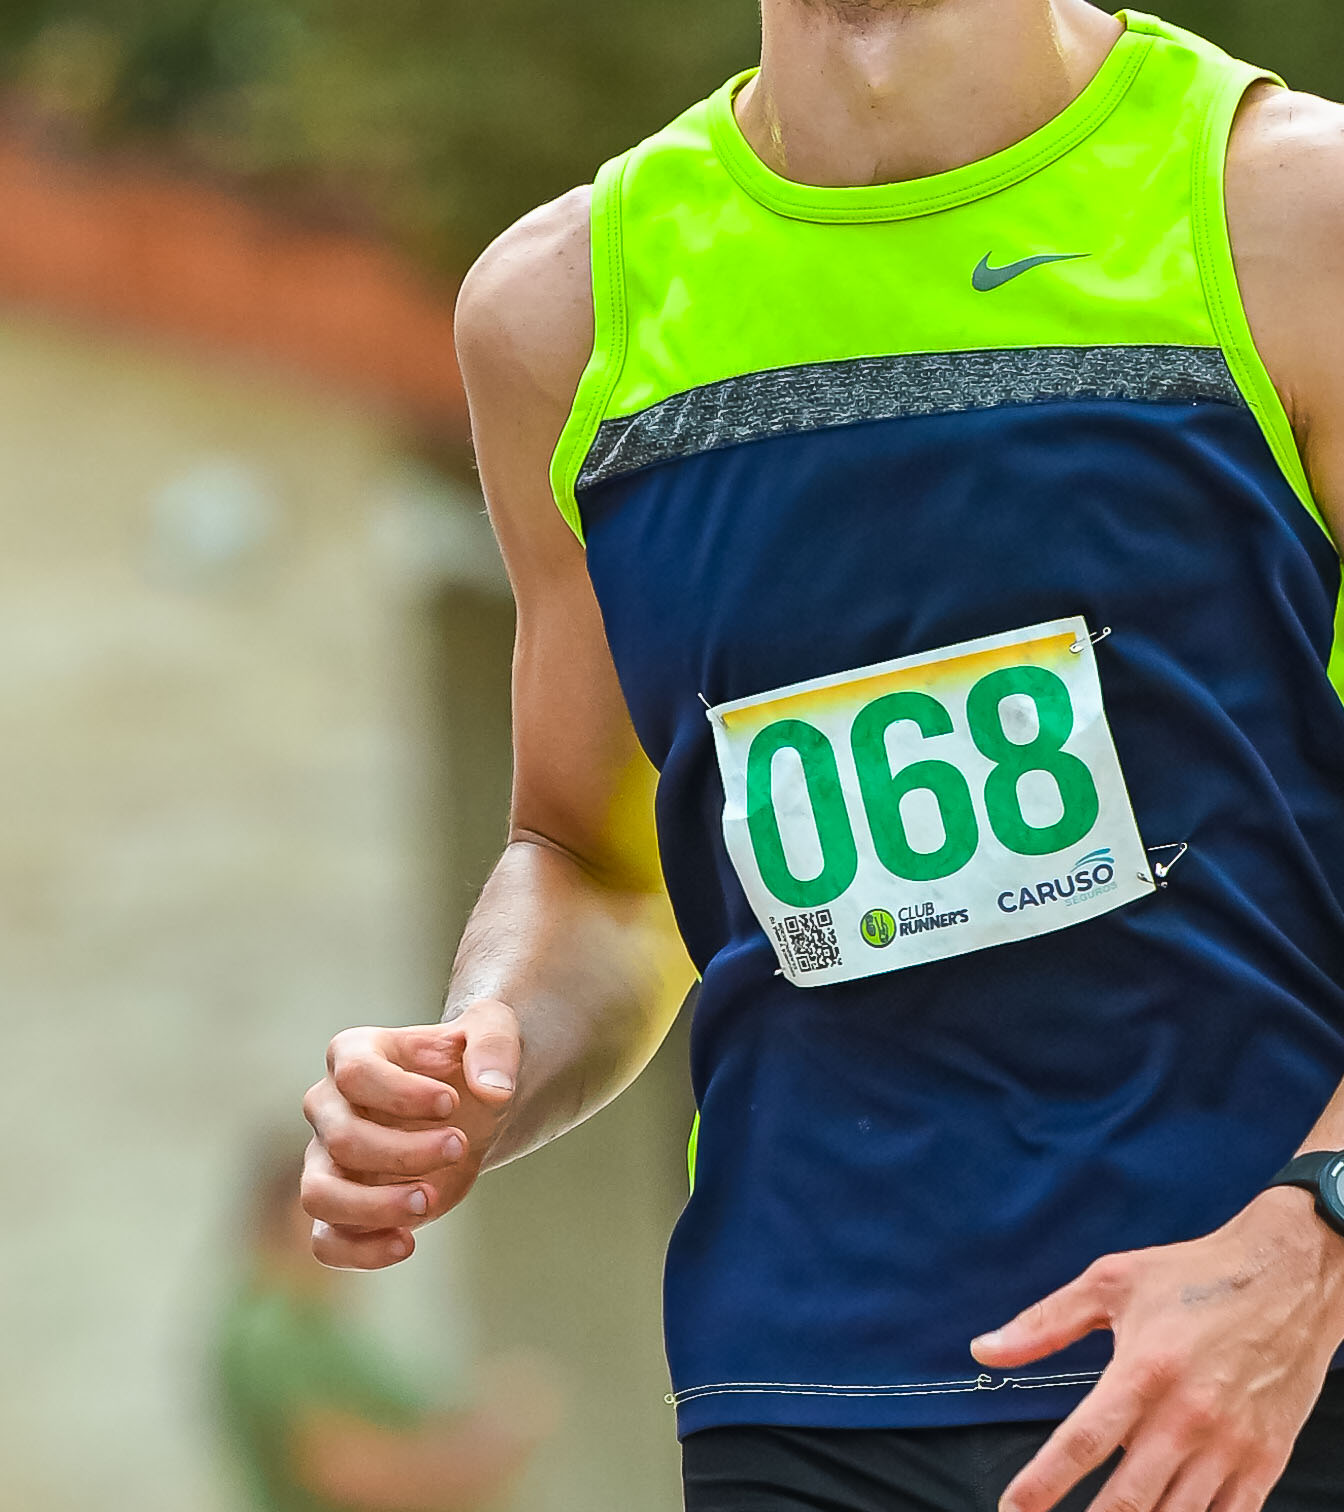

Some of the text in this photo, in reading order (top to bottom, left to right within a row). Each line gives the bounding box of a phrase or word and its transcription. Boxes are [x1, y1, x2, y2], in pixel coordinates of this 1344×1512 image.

[746, 665, 1100, 908] 068
[998, 864, 1113, 912] CARUSO
[1064, 882, 1118, 907] SEGUROS
[898, 902, 935, 921] CLUB
[899, 909, 969, 936] RUNNER'S
